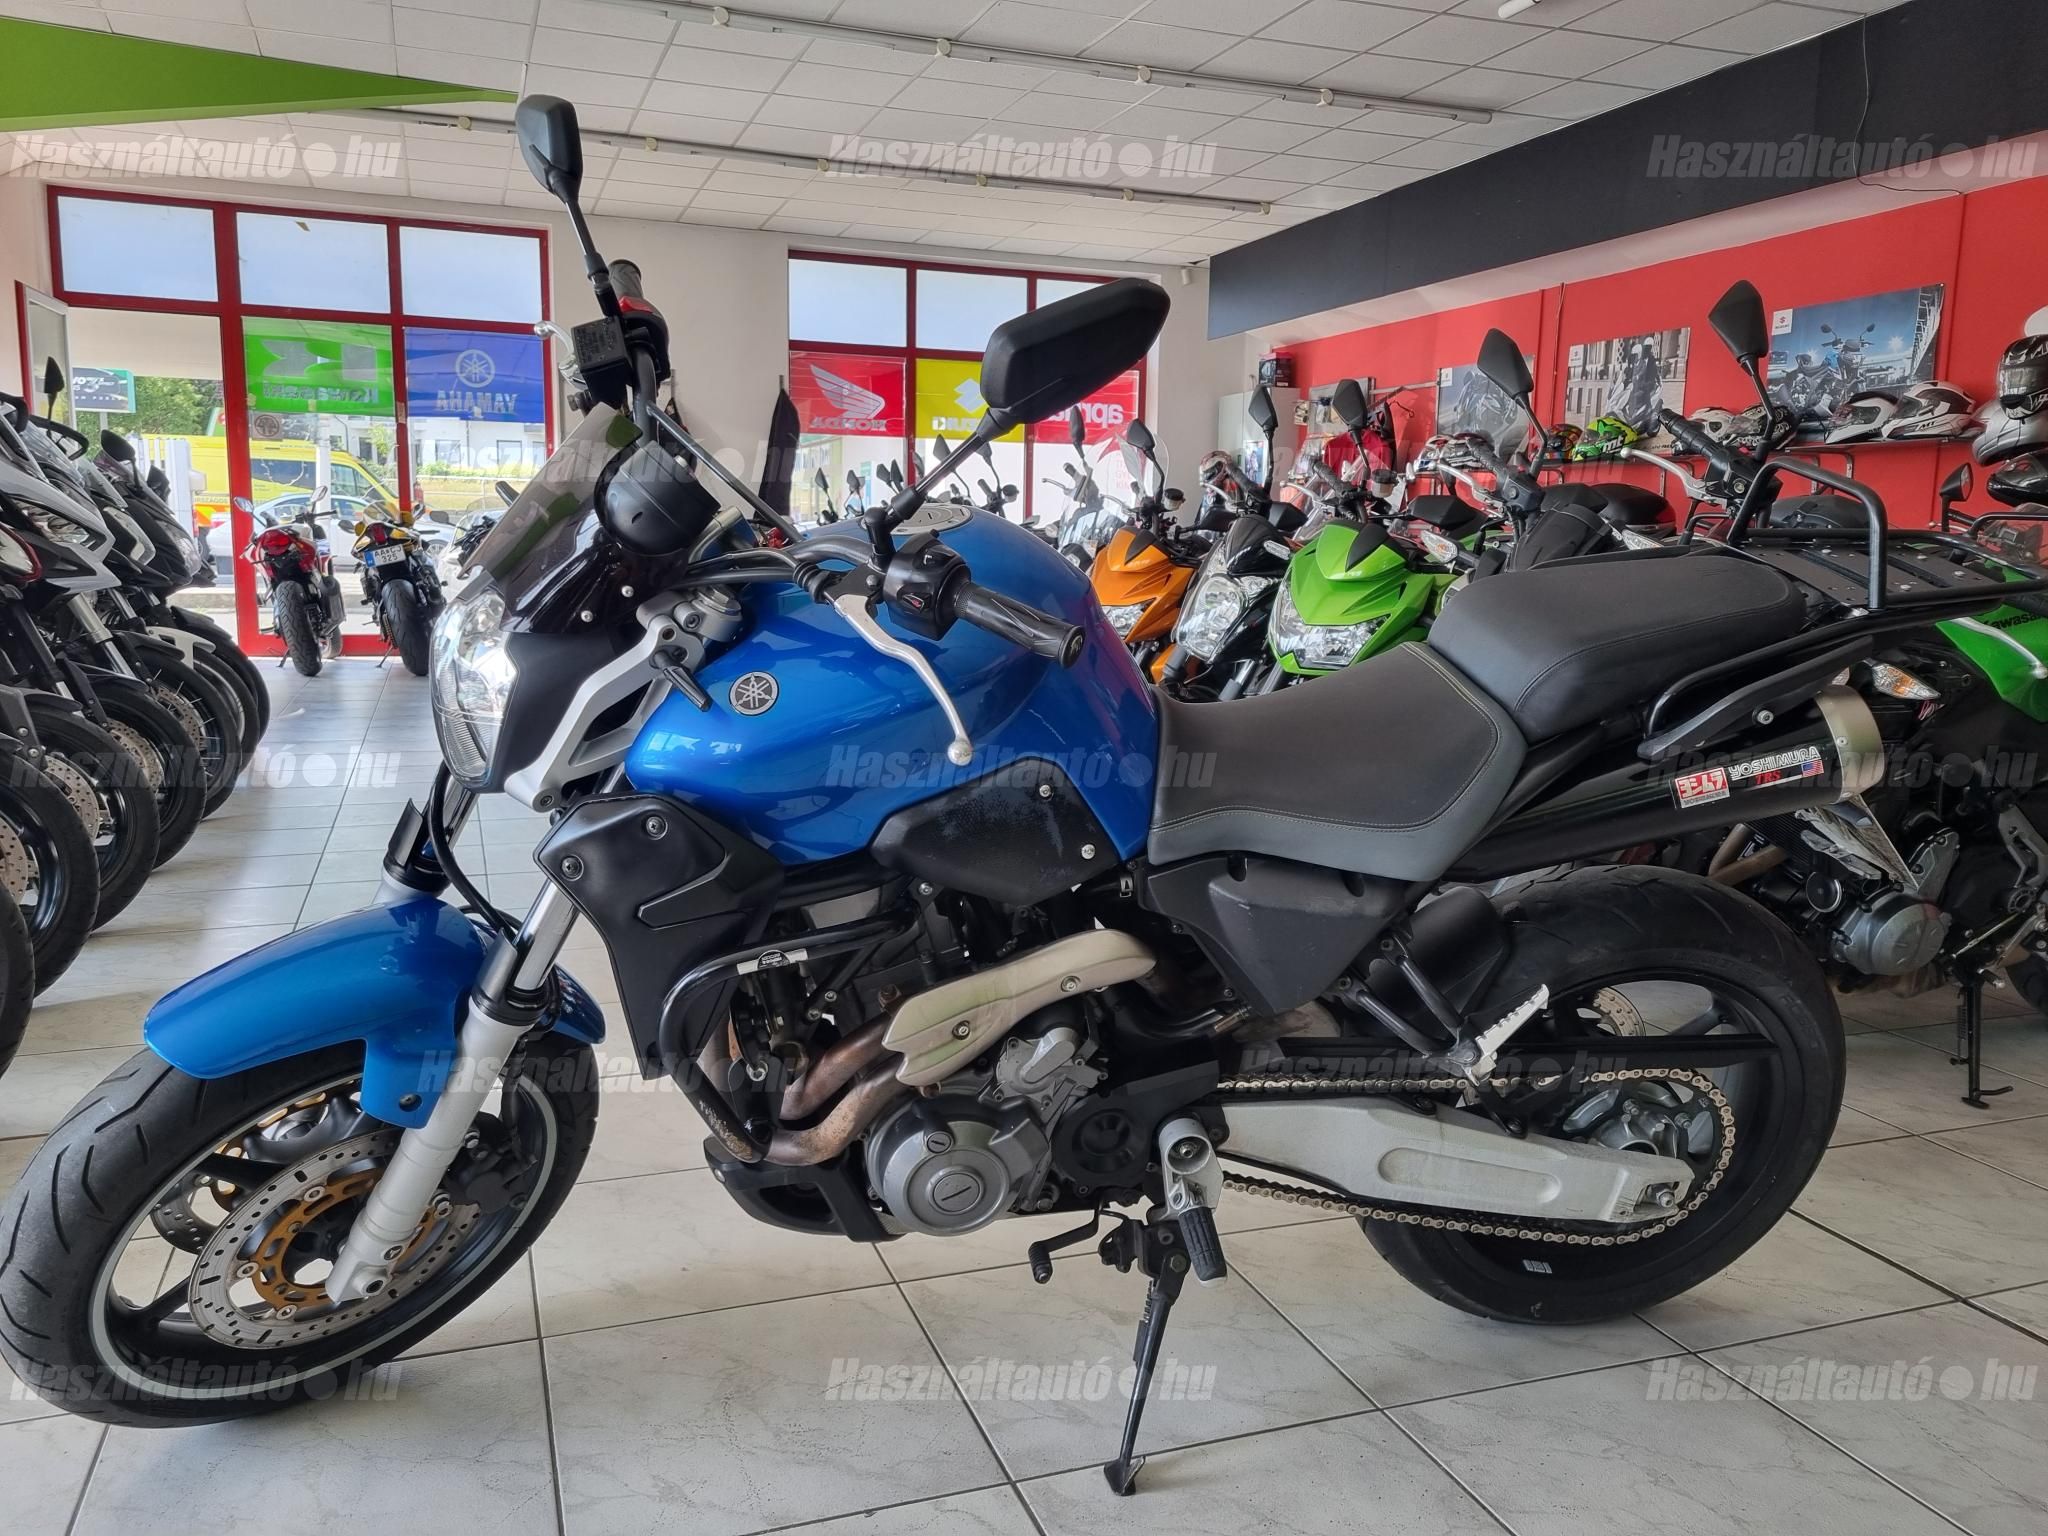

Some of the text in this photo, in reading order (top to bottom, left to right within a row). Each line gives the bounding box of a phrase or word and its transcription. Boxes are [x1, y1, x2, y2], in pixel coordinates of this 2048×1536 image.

[1602, 436, 1624, 453] mt
[1728, 746, 1821, 779] YOSHIMURA
[1756, 770, 1782, 785] TRS
